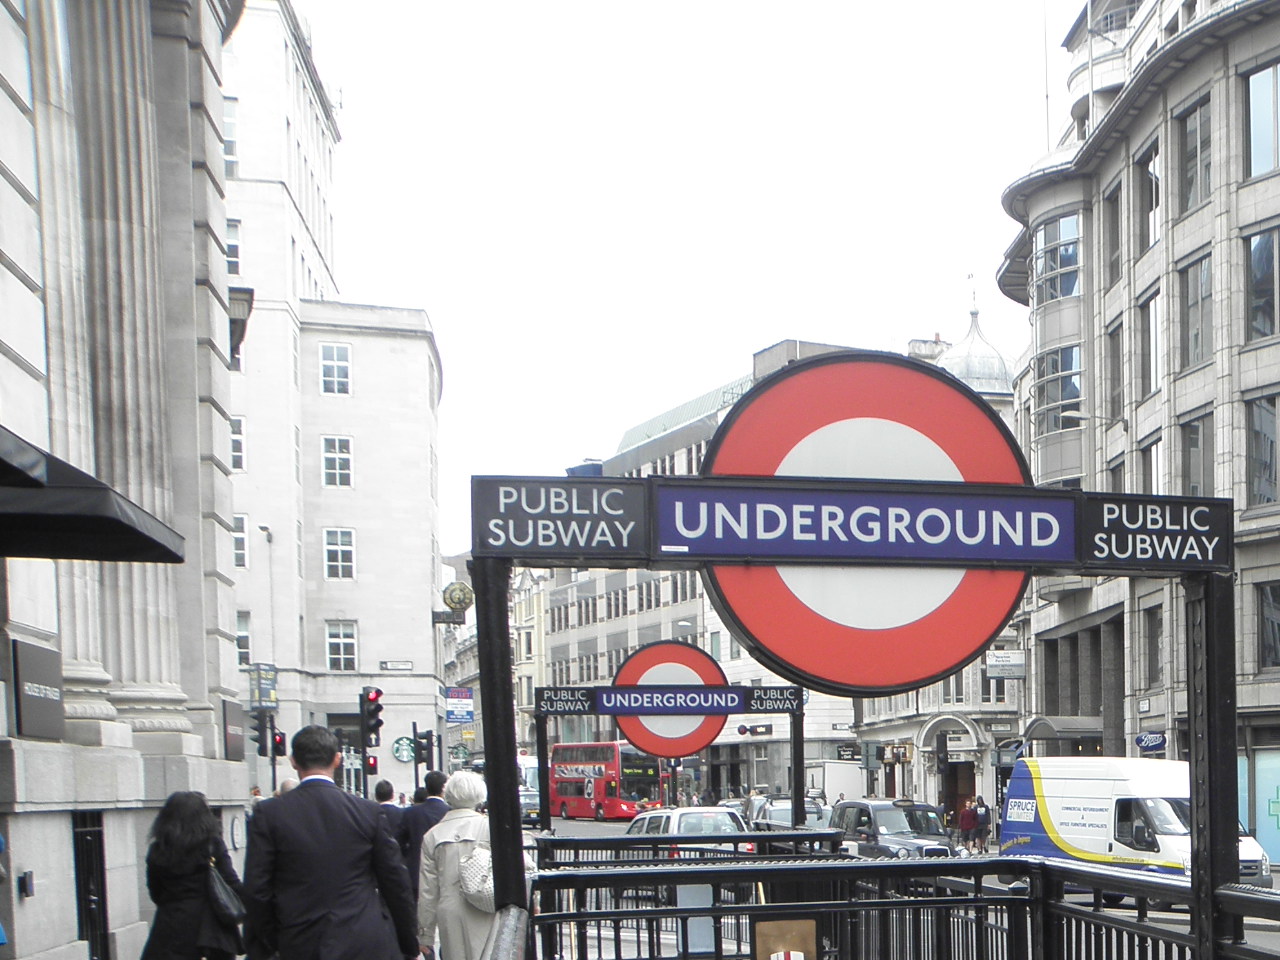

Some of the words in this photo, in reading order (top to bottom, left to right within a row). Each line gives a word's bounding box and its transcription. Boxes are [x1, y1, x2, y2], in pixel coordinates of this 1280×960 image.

[499, 486, 624, 515] PUBLIC
[1102, 503, 1211, 531] PUBLIC
[675, 501, 1060, 547] UNDERGROUND
[488, 518, 636, 547] SUBWAY
[1093, 533, 1220, 561] SUBWAY
[543, 690, 587, 700] PUBLIC
[603, 693, 739, 707] UNDERGROUND
[754, 689, 795, 699] PUBLIC
[540, 701, 590, 711] SUBWAY
[751, 700, 799, 710] SUBWAY
[1009, 800, 1036, 812] SPRUCE
[1012, 811, 1034, 821] LIMITED
